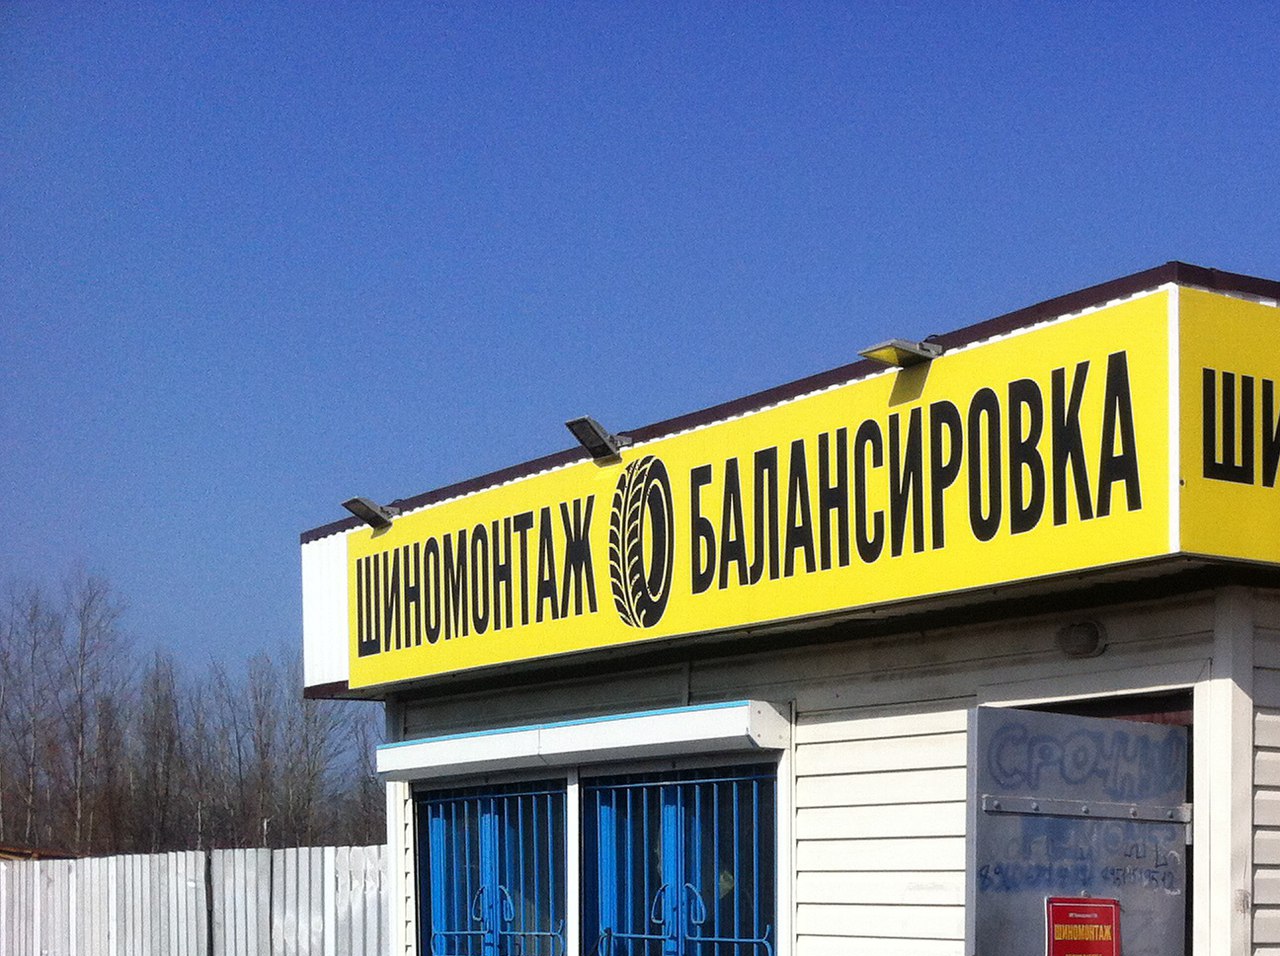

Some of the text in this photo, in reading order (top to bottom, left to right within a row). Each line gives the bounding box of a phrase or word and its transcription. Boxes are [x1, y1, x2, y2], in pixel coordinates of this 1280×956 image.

[354, 349, 1143, 658] ШИНОМОНТАЖ БАЛАНСИРОВКА
[1054, 924, 1112, 941] ШИНОМОНТАЖ
